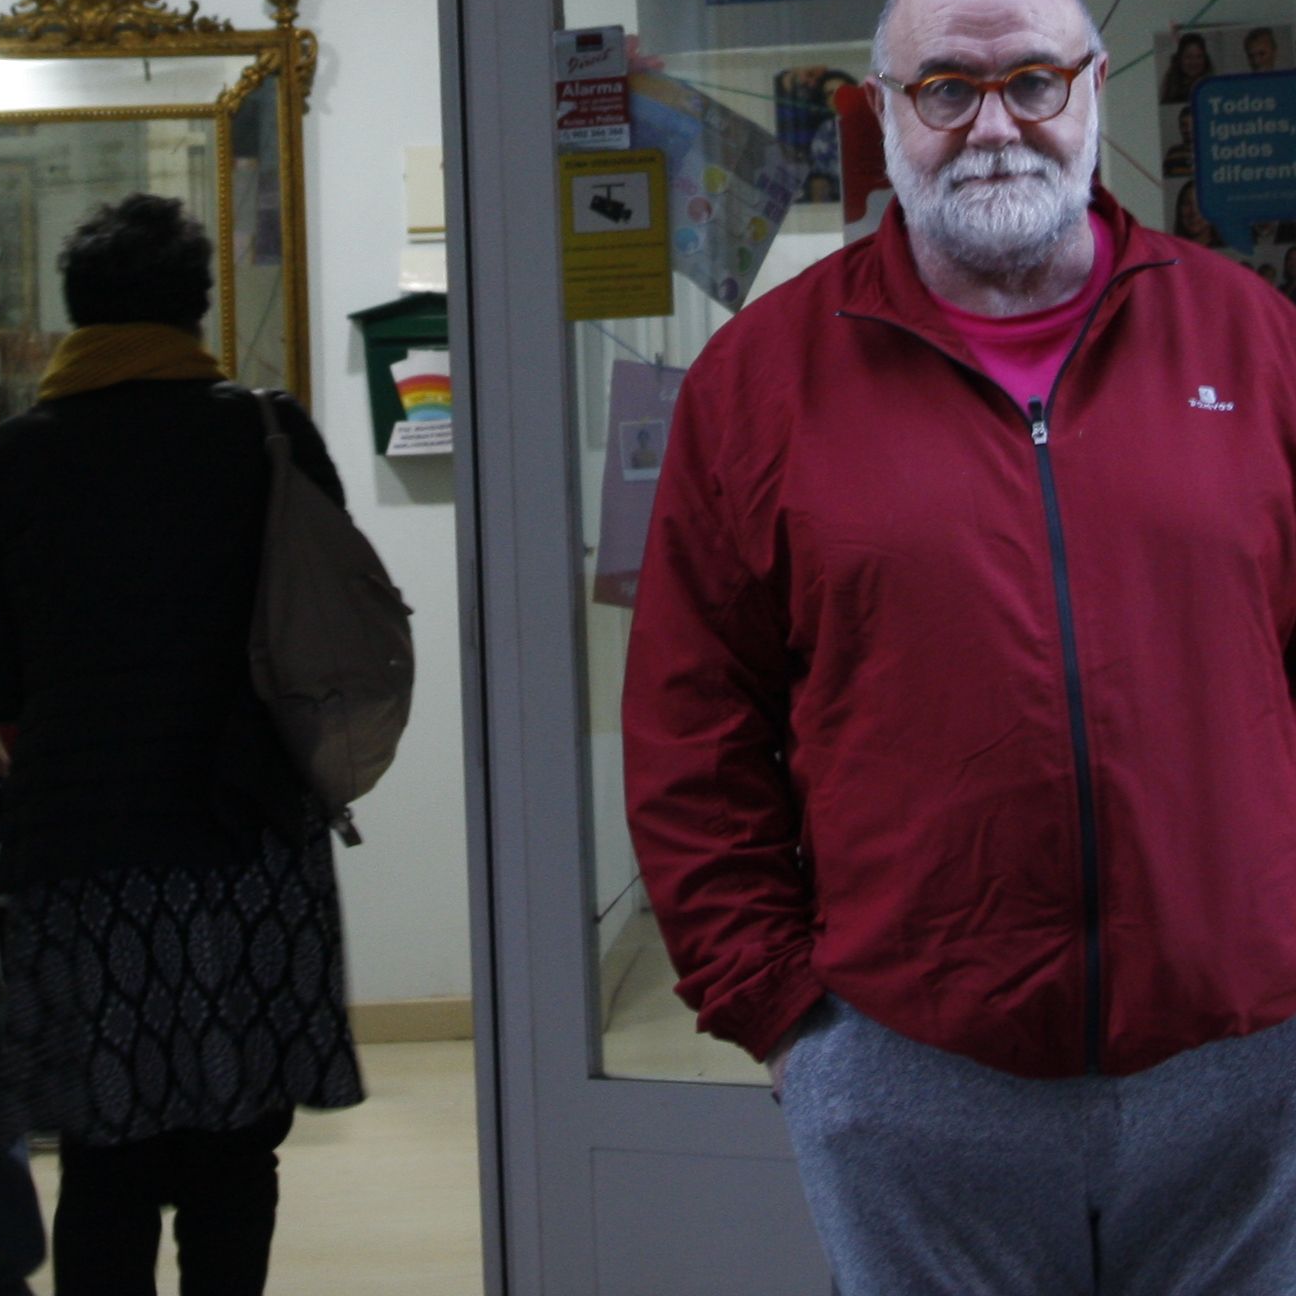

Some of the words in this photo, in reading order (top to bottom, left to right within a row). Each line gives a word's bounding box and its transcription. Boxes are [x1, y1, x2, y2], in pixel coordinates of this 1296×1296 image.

[562, 81, 623, 97] Alarma
[1208, 94, 1276, 114] Todos
[1210, 117, 1296, 141] iguales,
[1211, 142, 1273, 161] todos
